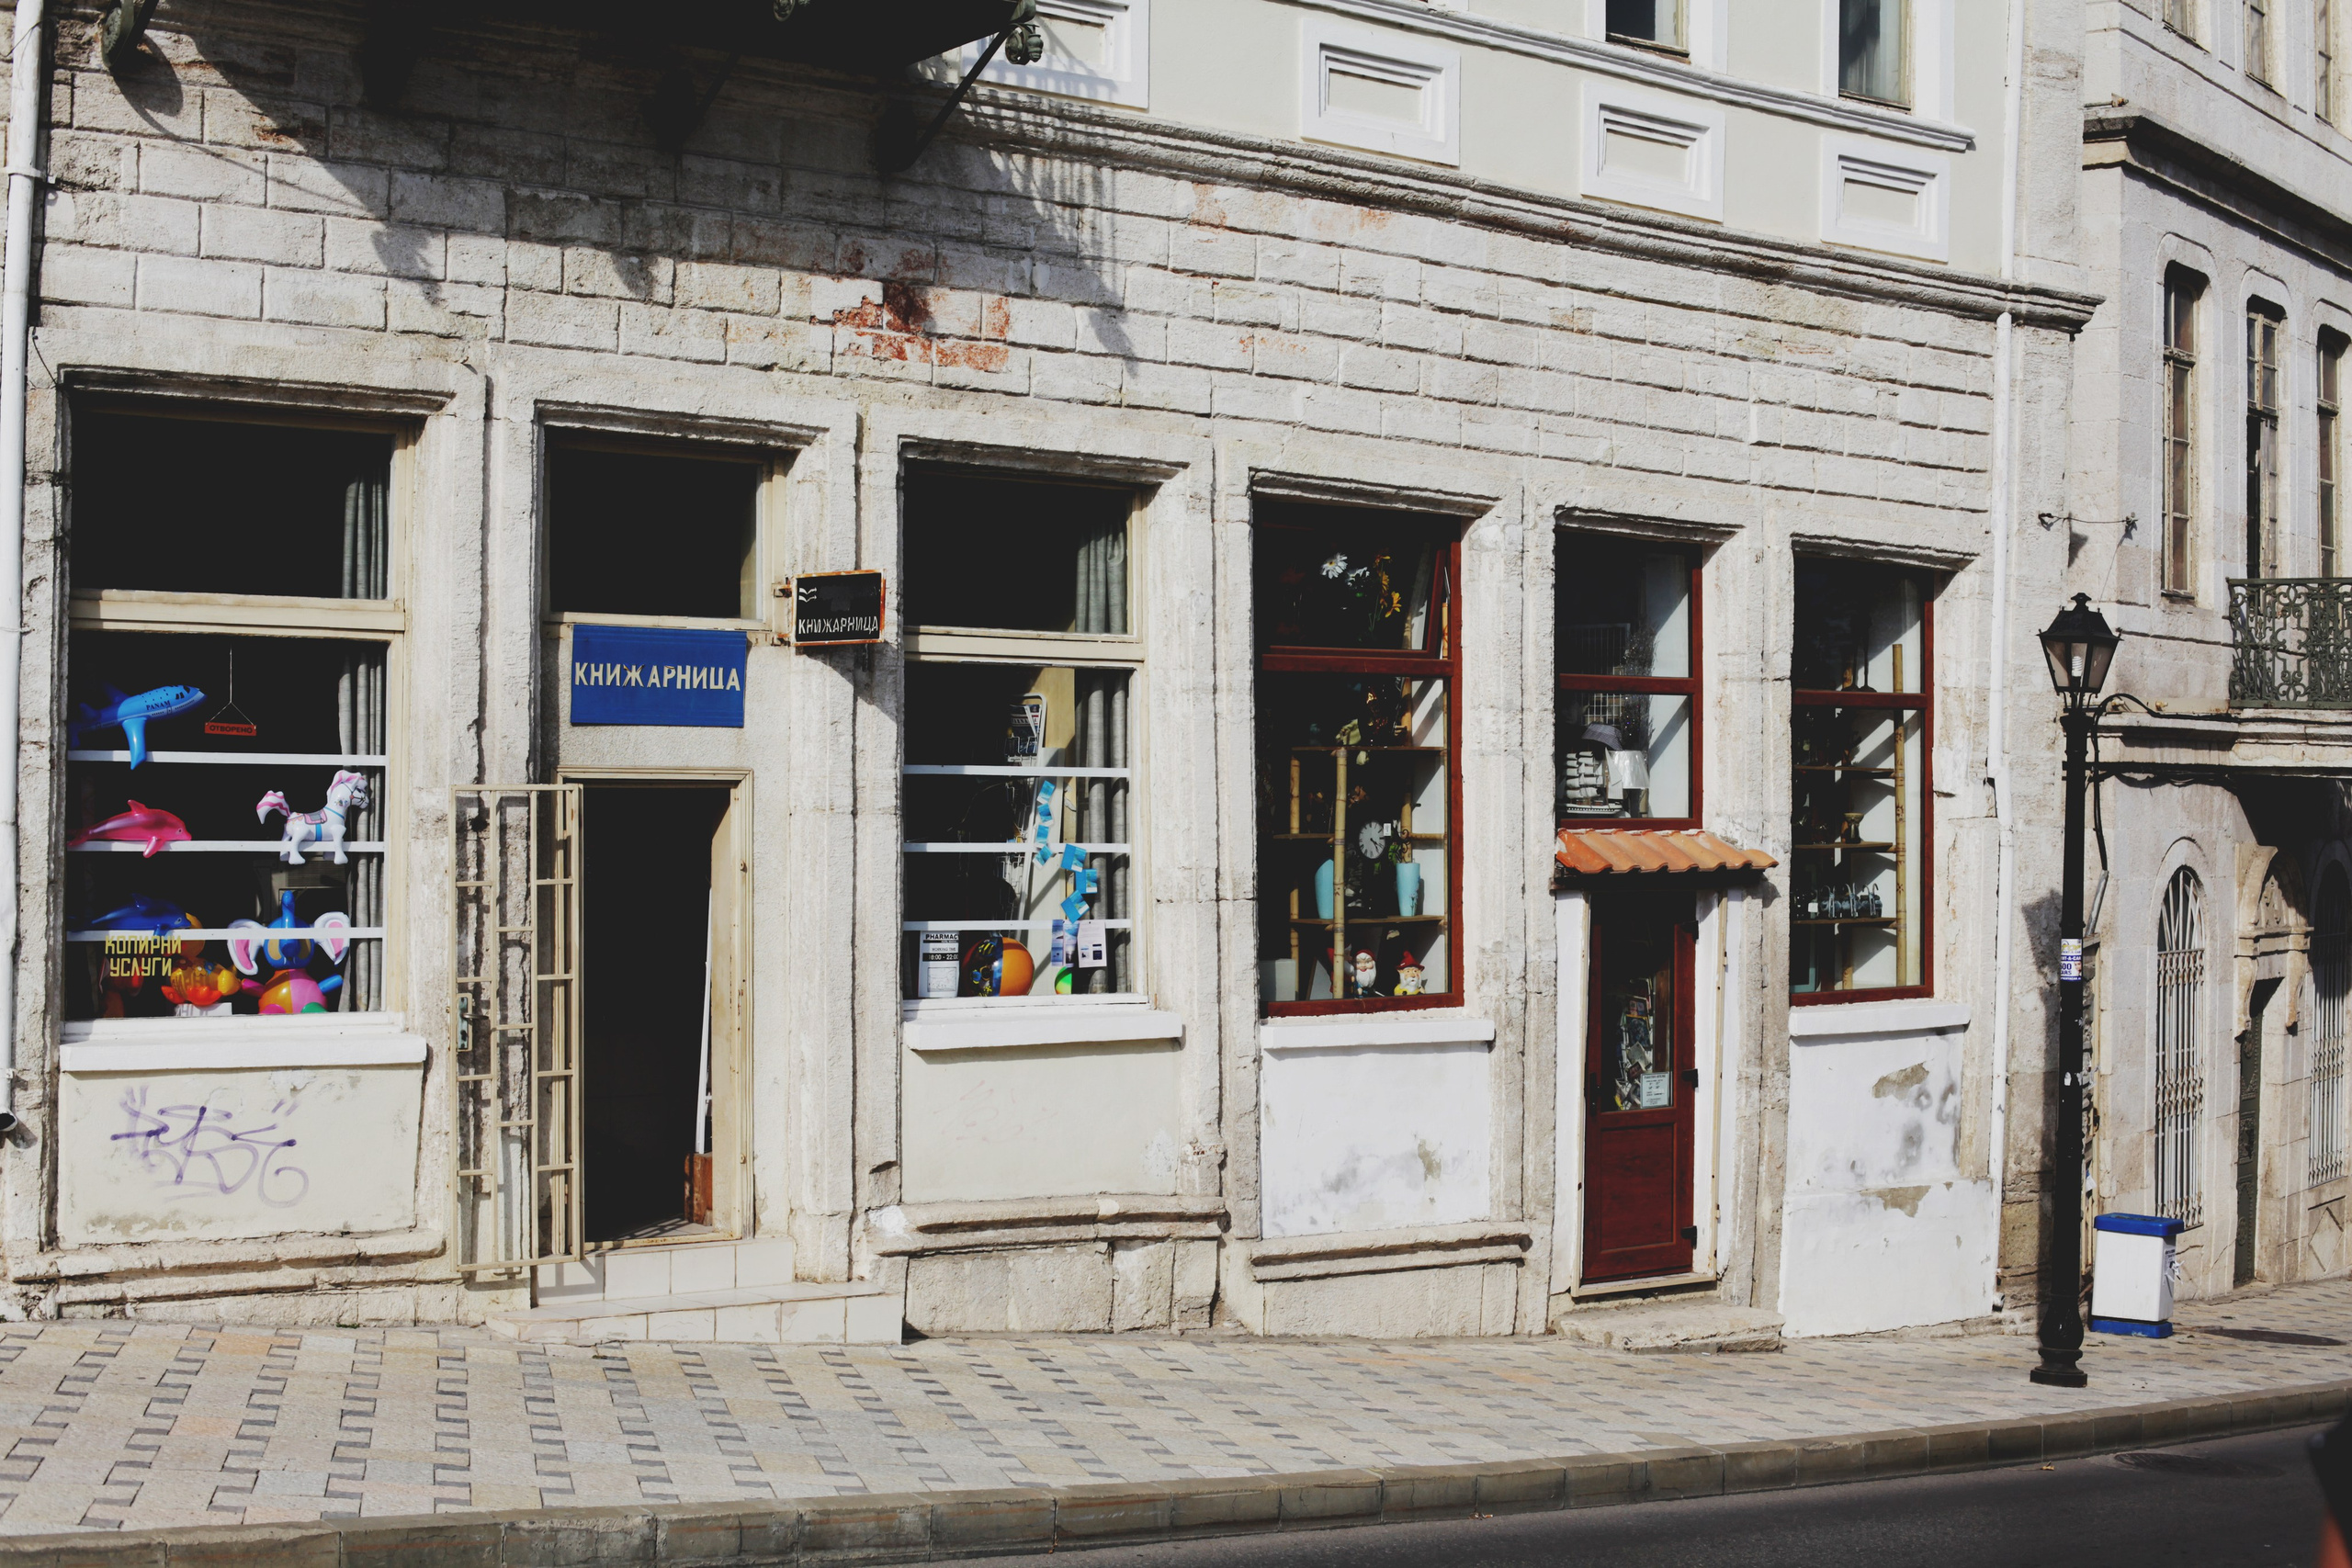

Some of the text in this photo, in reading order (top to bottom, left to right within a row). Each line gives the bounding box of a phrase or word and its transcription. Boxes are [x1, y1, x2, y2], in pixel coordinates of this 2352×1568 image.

[797, 615, 878, 635] КНИЖАРНИЦА
[574, 661, 741, 691] КНИЖАРНИЦА
[146, 699, 171, 711] PANAM
[209, 724, 253, 734] ОТВОРЕНО
[105, 935, 182, 954] КОПИРНИ
[109, 957, 172, 976] УСЛУГИ
